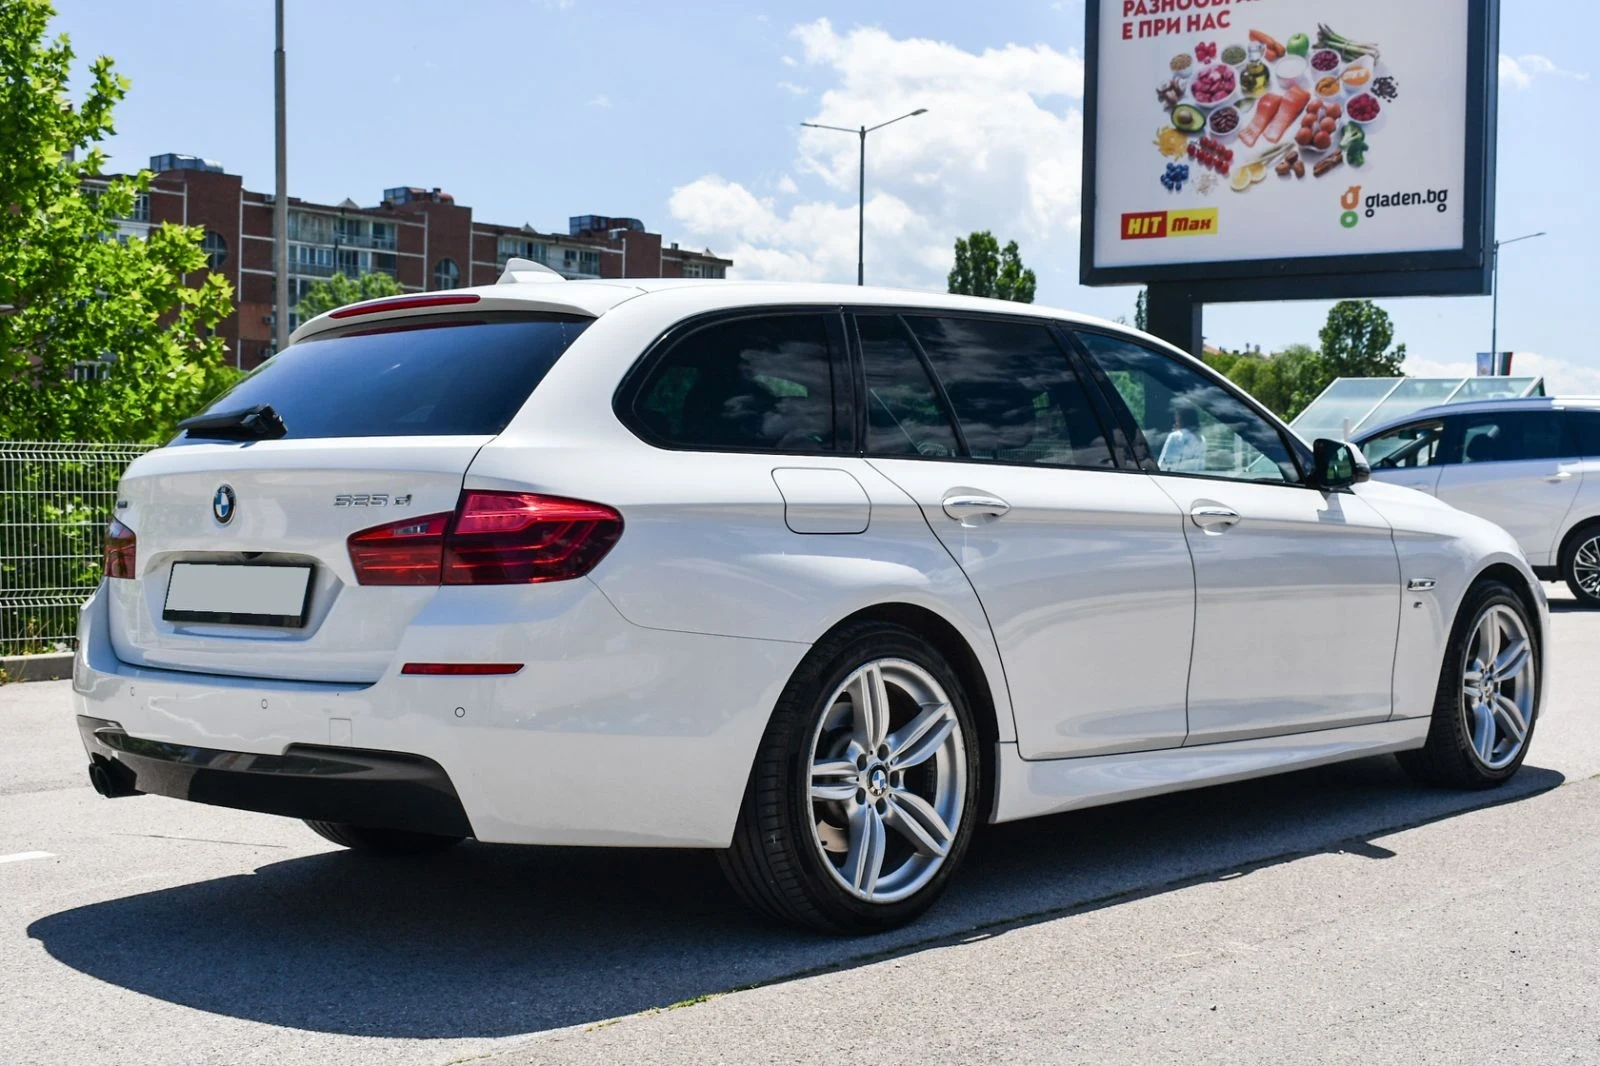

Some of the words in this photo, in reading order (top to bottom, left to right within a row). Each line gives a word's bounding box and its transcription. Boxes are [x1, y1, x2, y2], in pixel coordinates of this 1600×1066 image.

[1122, 22, 1133, 40] Е
[1138, 17, 1181, 38] ПРИ
[1187, 10, 1231, 33] НАС
[1365, 188, 1448, 218] gladen.bg
[1127, 216, 1162, 235] HIT
